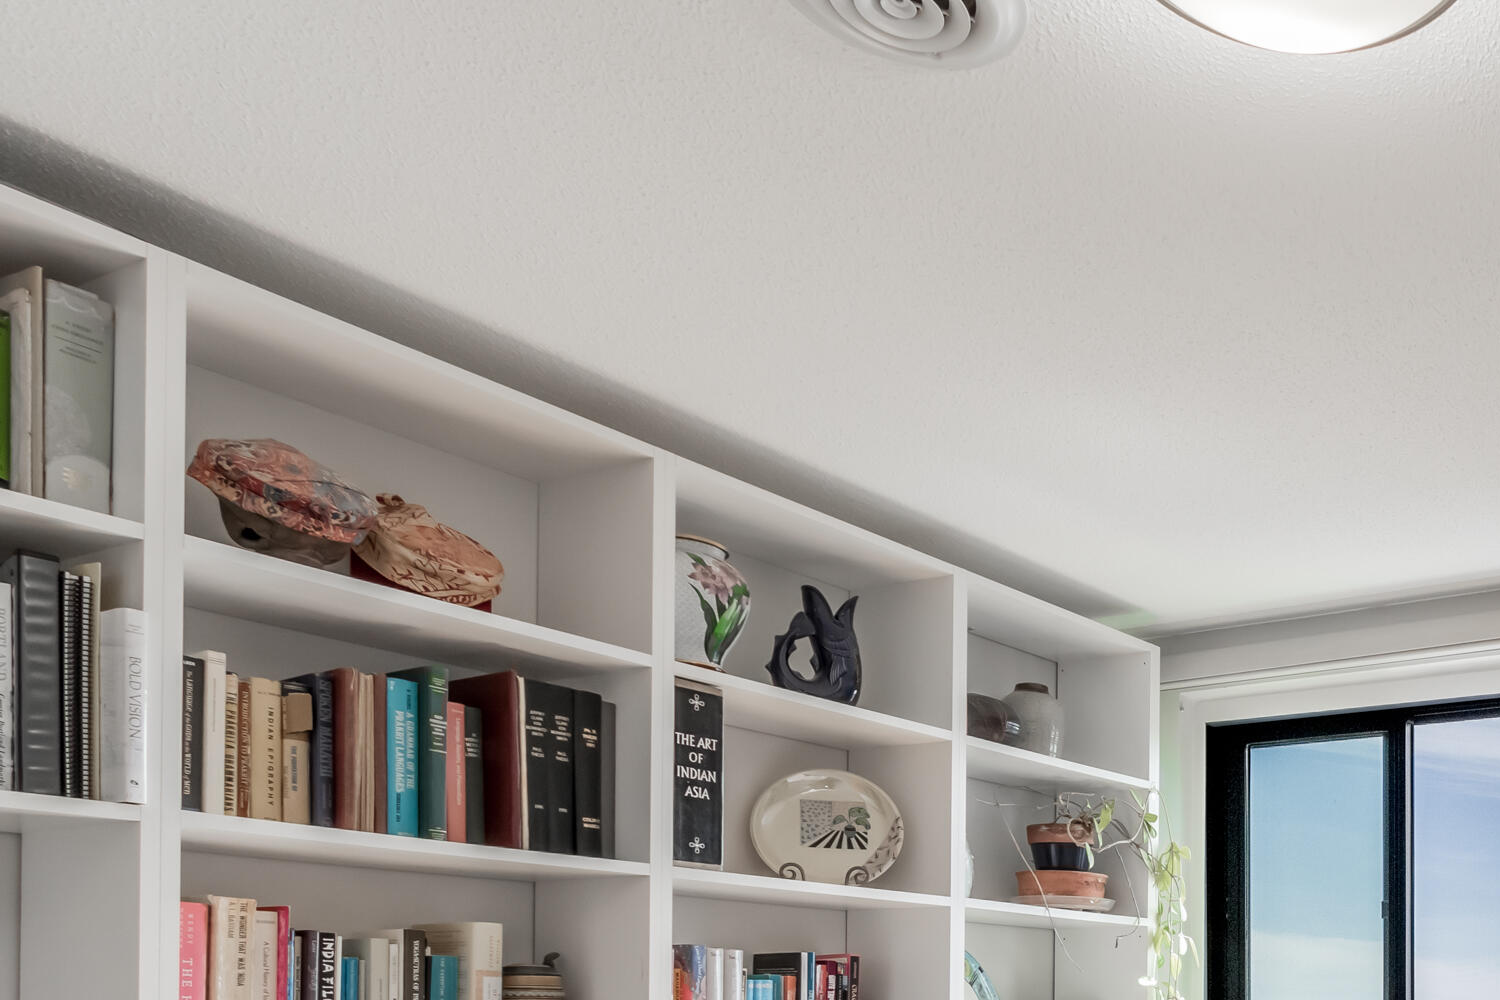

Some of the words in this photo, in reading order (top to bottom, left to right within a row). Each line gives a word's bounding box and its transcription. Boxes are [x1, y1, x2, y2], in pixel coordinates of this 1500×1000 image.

[129, 656, 142, 691] BOLD
[225, 692, 237, 706] THE
[319, 680, 333, 722] SPOKEN
[129, 694, 142, 739] VISION
[241, 690, 250, 743] INTRODUCTION
[319, 726, 333, 778] MARATHI
[675, 731, 696, 748] THE
[697, 737, 718, 752] ART
[688, 752, 704, 764] OF
[267, 748, 275, 807] EPIGRAPHY
[395, 747, 405, 793] LANGUAGES
[676, 765, 717, 784] INDIAN
[406, 774, 415, 789] THE
[684, 785, 711, 800] ASIA
[238, 902, 249, 912] THE
[238, 915, 248, 939] WONDER
[238, 941, 248, 954] THAT
[322, 937, 334, 973] INDIA
[181, 957, 193, 987] THE
[237, 957, 247, 970] WAS
[412, 982, 420, 991] OF
